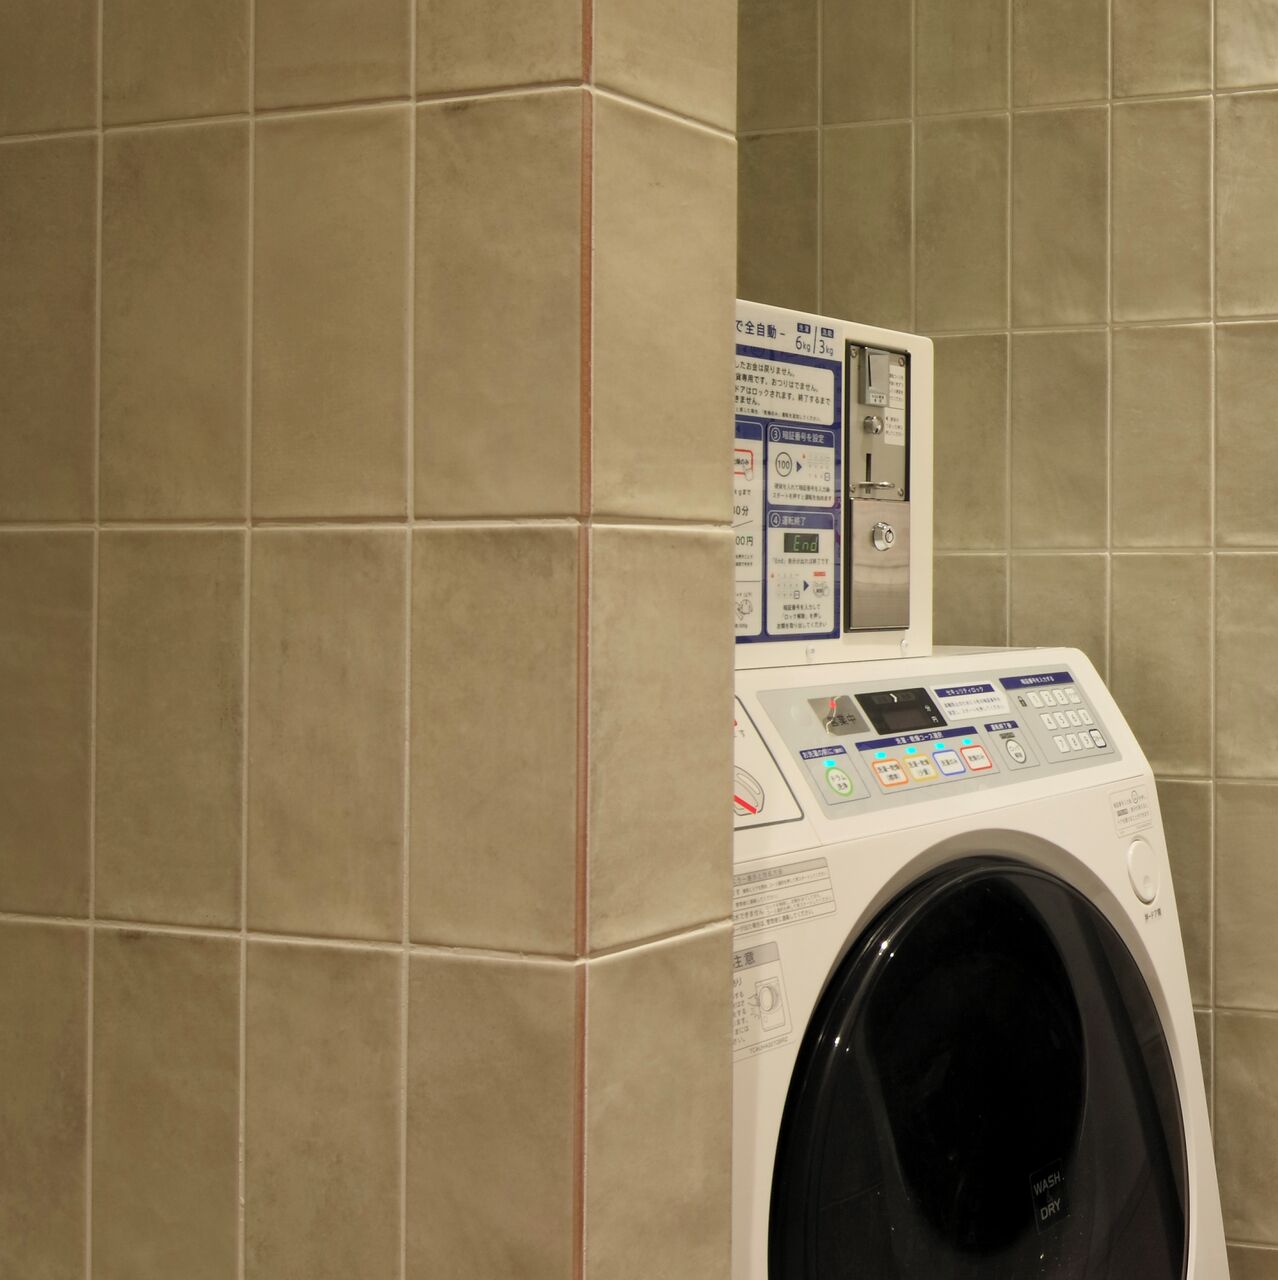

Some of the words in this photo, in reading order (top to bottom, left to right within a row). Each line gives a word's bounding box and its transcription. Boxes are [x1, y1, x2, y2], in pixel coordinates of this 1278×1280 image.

[795, 336, 811, 352] 6kg
[819, 340, 833, 356] 3kg
[778, 461, 790, 469] 100
[794, 536, 818, 552] End
[1033, 1170, 1061, 1197] WASH
[1040, 1198, 1061, 1220] DRY
